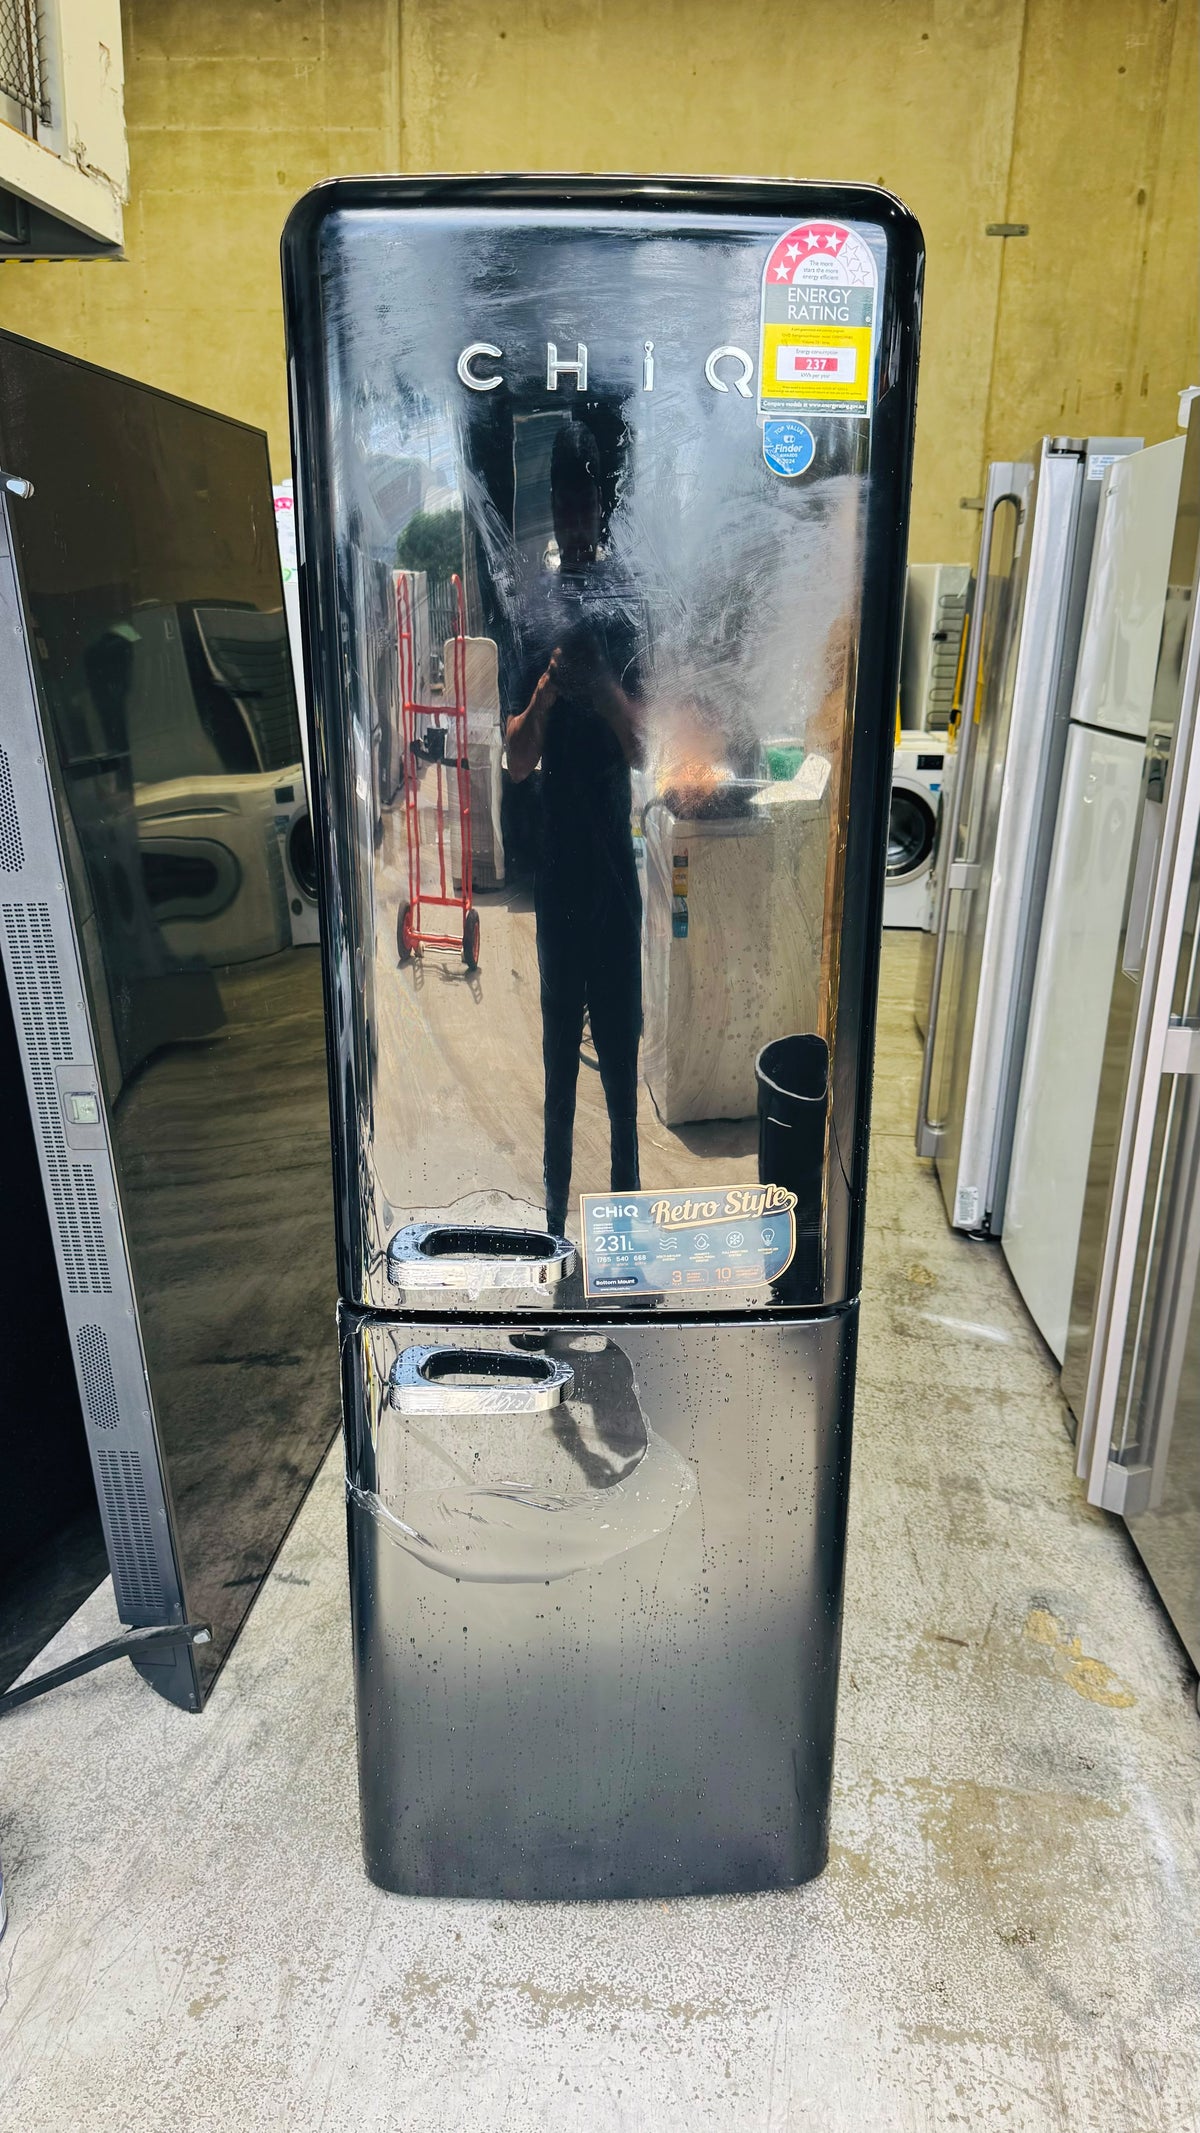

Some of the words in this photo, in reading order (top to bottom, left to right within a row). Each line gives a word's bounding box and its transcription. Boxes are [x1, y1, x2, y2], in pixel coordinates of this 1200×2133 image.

[788, 287, 852, 304] ENERGY
[788, 305, 850, 321] RATING
[805, 359, 827, 370] 237
[774, 425, 785, 435] TOP
[786, 425, 804, 435] VALUE
[775, 444, 803, 453] Finder
[650, 1200, 721, 1224] Retro
[724, 1186, 790, 1218] Style
[672, 1271, 682, 1283] 3
[715, 1268, 732, 1279] 10
